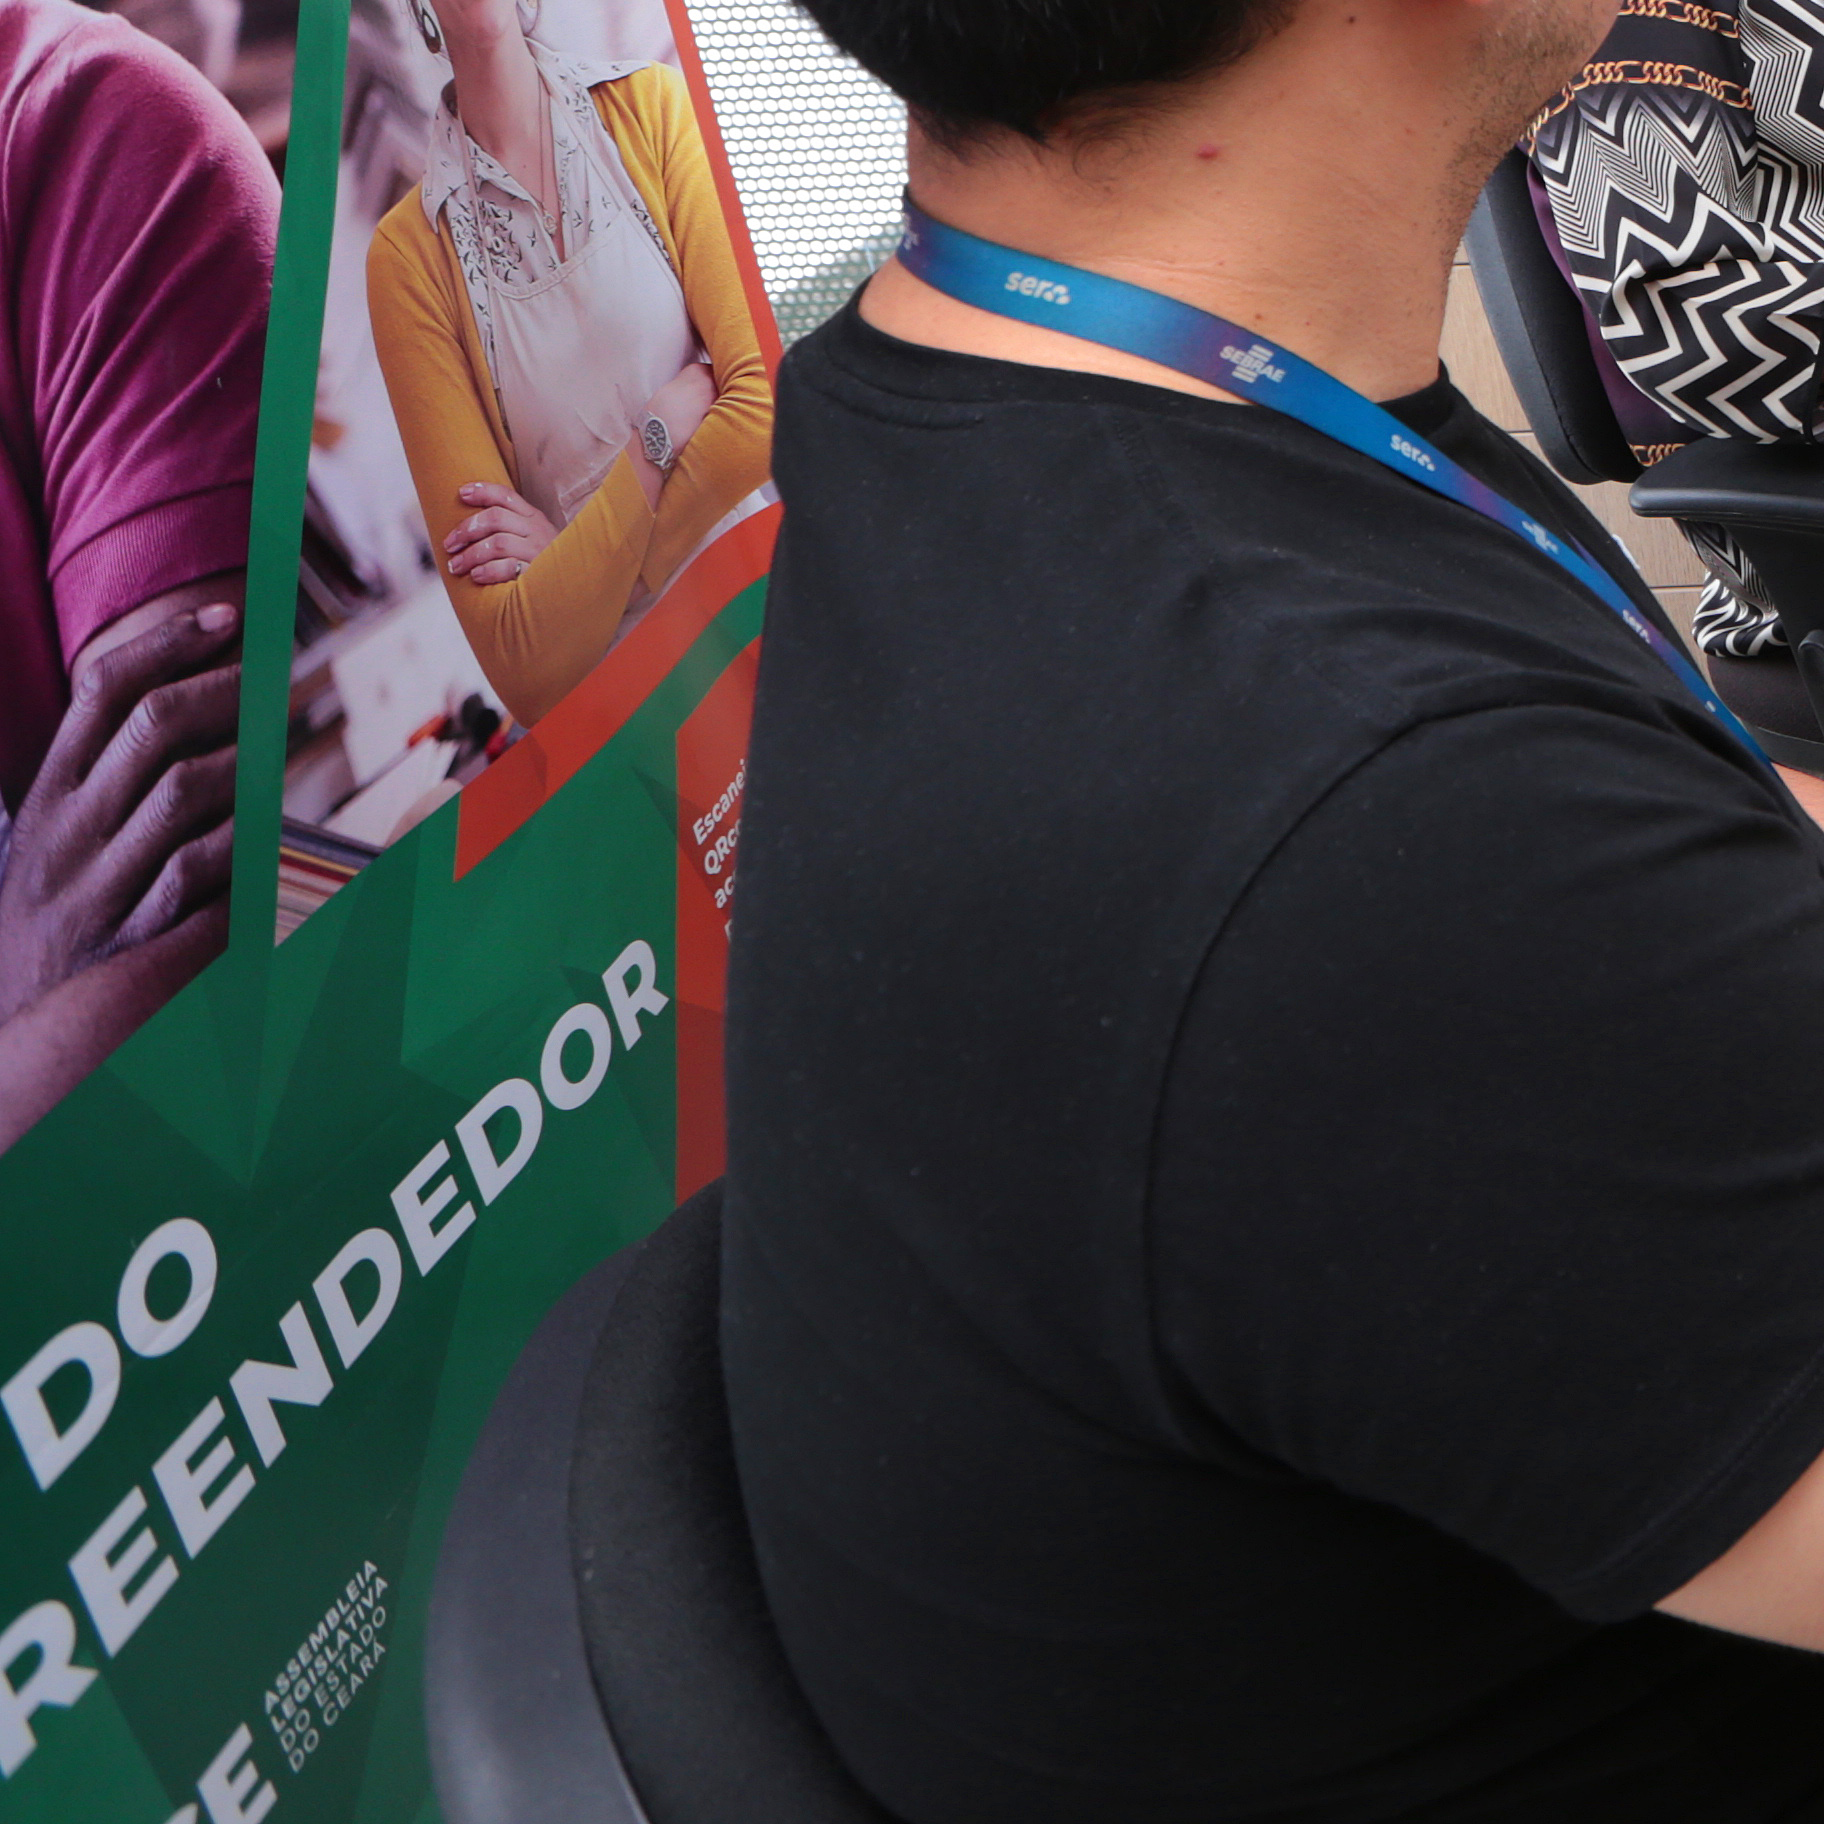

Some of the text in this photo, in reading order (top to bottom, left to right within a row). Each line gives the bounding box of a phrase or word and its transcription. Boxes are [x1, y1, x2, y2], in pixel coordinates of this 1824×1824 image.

[1219, 345, 1287, 383] SEBRAE
[0, 1217, 218, 1493] DO
[264, 1560, 378, 1715] ASSEMBLEIA
[270, 1576, 389, 1733] LEGISLATIVA
[280, 1605, 387, 1754] DO ESTADO
[288, 1636, 386, 1774] DO CEARÁ
